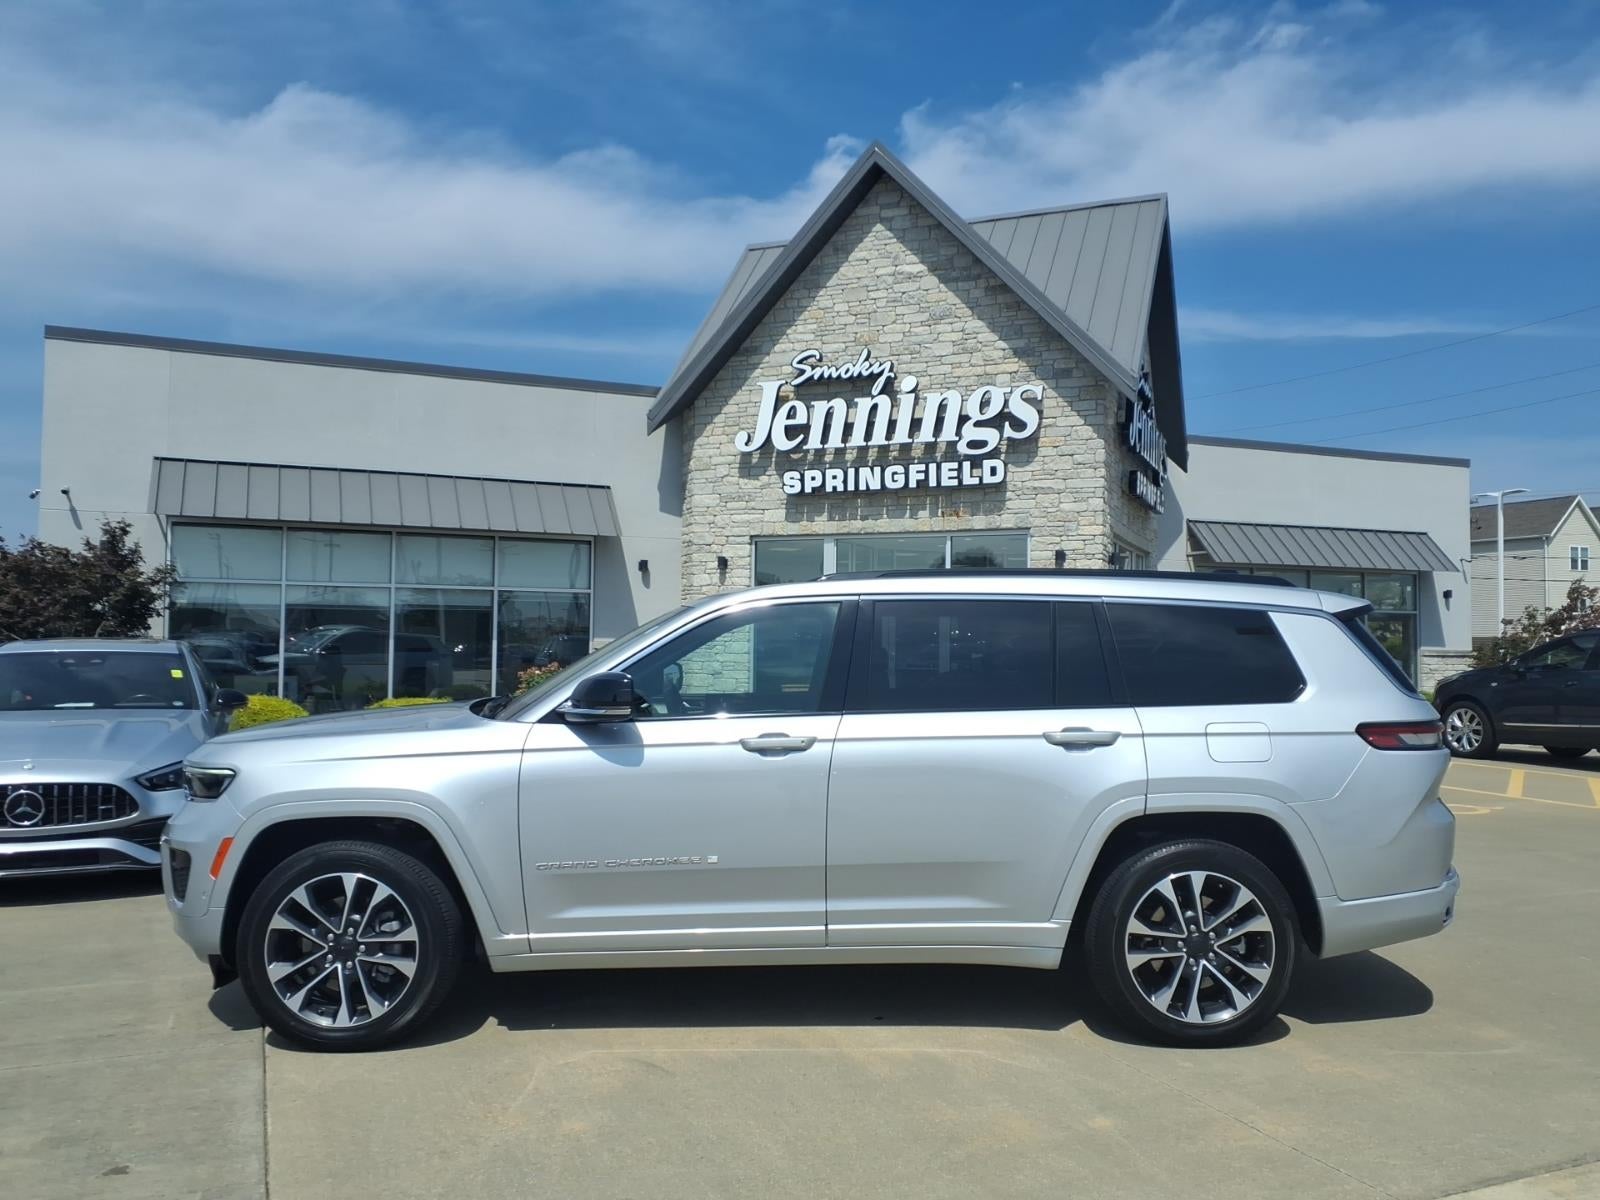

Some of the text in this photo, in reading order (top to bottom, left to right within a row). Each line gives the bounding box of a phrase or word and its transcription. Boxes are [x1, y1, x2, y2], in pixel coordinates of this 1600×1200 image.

[791, 347, 895, 396] Smoky
[735, 376, 1044, 456] Jennings
[783, 458, 1006, 495] SPRINGFIELD
[535, 860, 599, 871] GRAND
[604, 856, 702, 868] CHEROKEE
